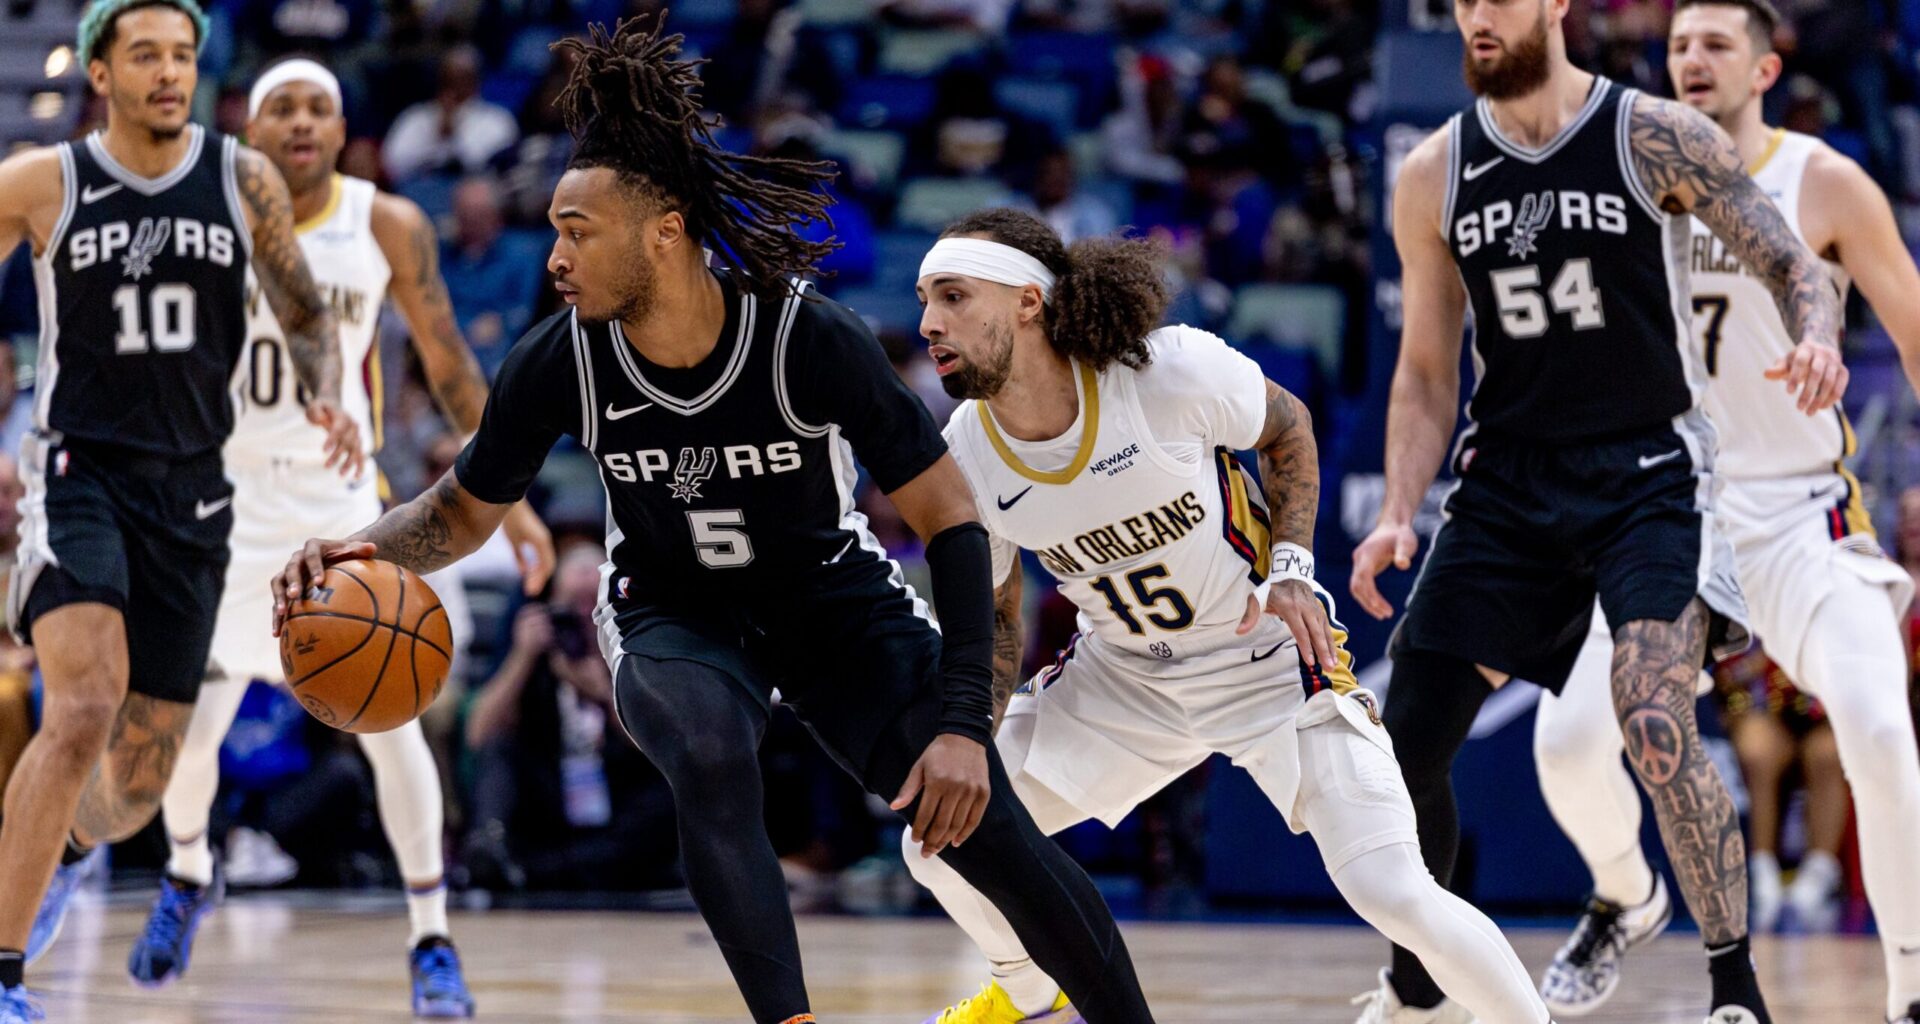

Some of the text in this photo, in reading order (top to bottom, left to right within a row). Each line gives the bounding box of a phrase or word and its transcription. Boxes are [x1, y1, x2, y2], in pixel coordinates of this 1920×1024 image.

[69, 217, 236, 280] SPURS
[1455, 190, 1628, 260] SPURS
[112, 282, 197, 355] 10
[1489, 257, 1606, 339] 54
[604, 441, 802, 503] SPURS
[1090, 443, 1140, 475] NEWAGE
[1107, 460, 1134, 477] GRILLS
[685, 508, 755, 569] 5
[1074, 491, 1205, 565] ORLEANS
[1088, 561, 1196, 636] 15
